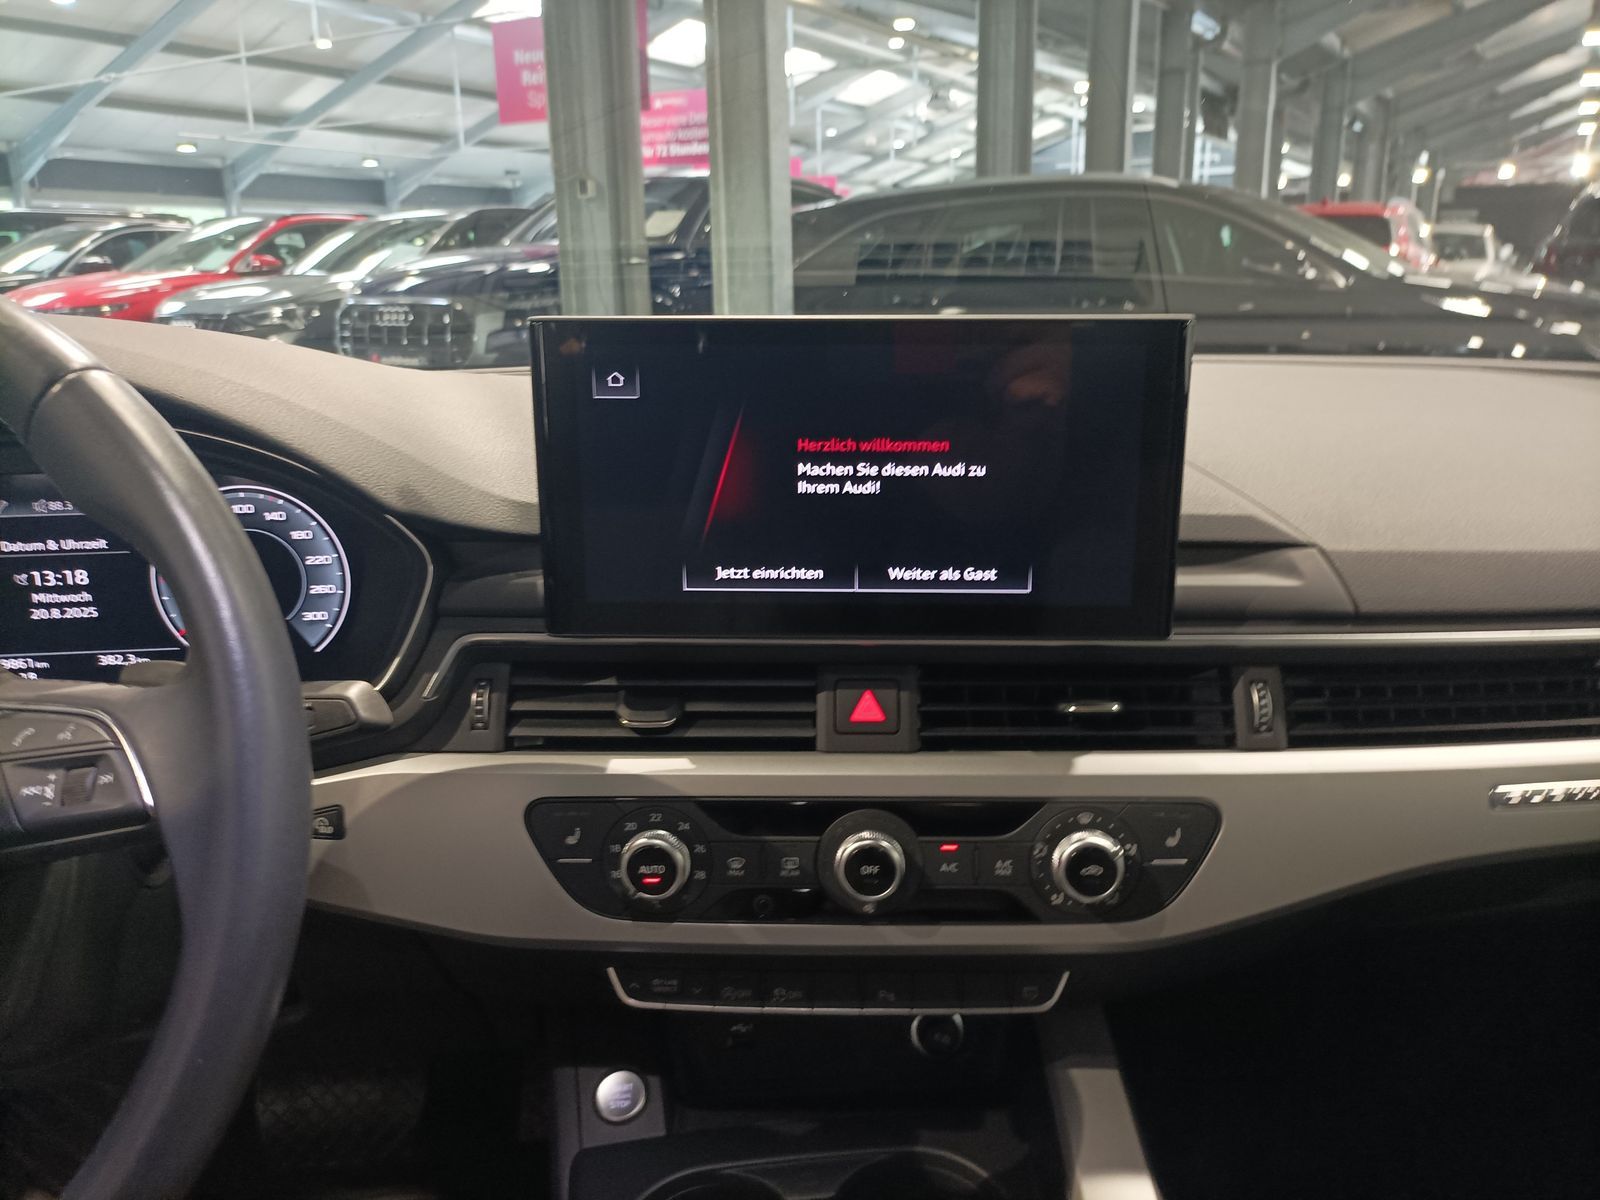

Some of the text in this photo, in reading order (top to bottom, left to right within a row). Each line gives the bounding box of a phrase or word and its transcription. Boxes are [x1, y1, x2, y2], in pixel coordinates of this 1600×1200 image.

[797, 438, 950, 452] Herzlich willkommen
[797, 462, 987, 477] Machen Sie diesen Audi zu
[797, 480, 881, 495] Ihrem Audi!
[231, 504, 255, 514] 100
[263, 511, 287, 521] 140
[0, 538, 109, 553] Datum & Uhrzeit
[305, 555, 333, 565] 220
[29, 569, 90, 587] 13:18
[715, 566, 824, 581] Jetzt einrichten
[888, 566, 998, 581] Weiter als Gast
[309, 584, 337, 594] 260
[30, 591, 94, 604] Mittwoch
[29, 606, 99, 620] 20.8.2025
[301, 611, 329, 621] 300
[649, 813, 662, 822] 22
[623, 822, 638, 831] 20
[677, 821, 691, 831] 24
[638, 864, 666, 875] AUTO
[860, 864, 881, 876] OFF
